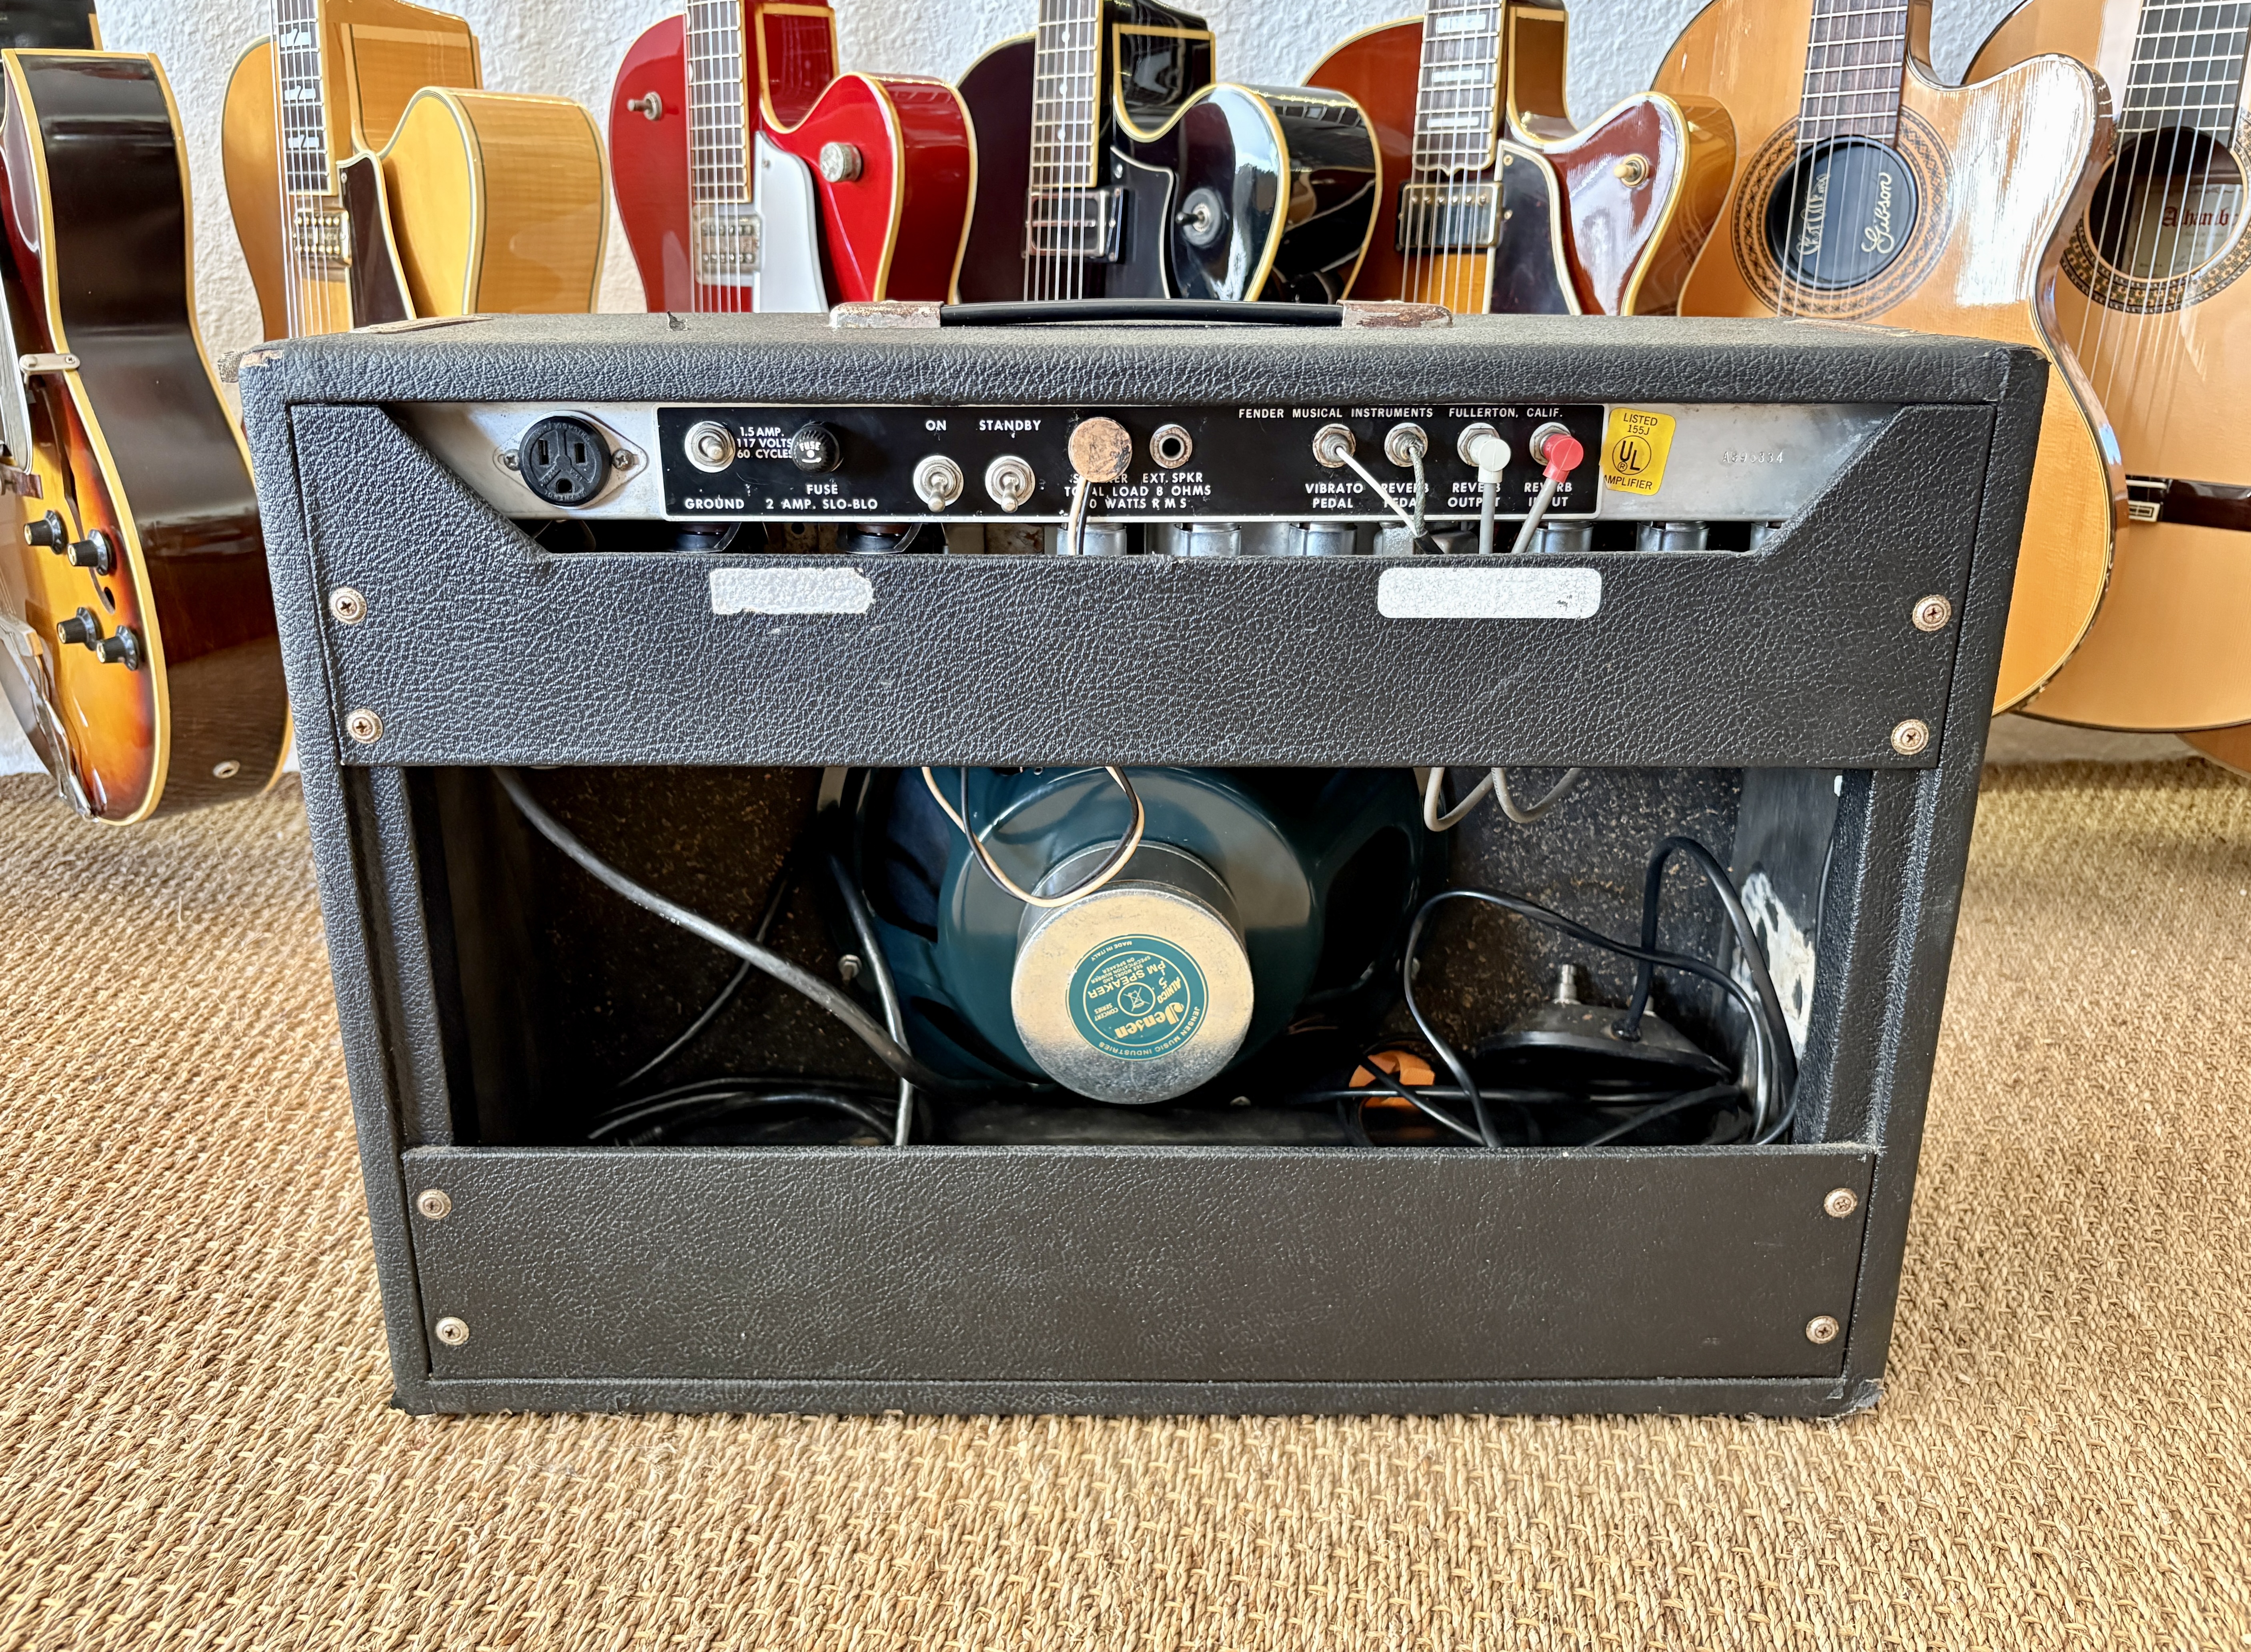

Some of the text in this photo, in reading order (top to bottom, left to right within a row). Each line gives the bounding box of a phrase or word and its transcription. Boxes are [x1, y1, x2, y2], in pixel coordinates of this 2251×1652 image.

[1861, 172, 1894, 254] Gibson
[1239, 408, 1563, 418] FENDER MUSICAL INSTRUMENTS FULLERTON, CALIF.
[1623, 412, 1658, 426] LISTED
[925, 420, 947, 431] ON
[979, 420, 1041, 431] STANDBY
[1627, 424, 1650, 435] 155J
[740, 427, 785, 437] 1.5 AMP.
[737, 438, 792, 448] 117 VOLTS
[799, 441, 821, 452] FUSE
[1619, 440, 1640, 471] UL
[1143, 472, 1203, 484] EXT. SPKR
[807, 484, 838, 495] FUSE
[1064, 485, 1211, 497] TAL LOAD 8 OHMS
[1305, 483, 1364, 494] VIBRATO
[1452, 482, 1501, 493] REVEB
[1524, 482, 1572, 493] RERB
[685, 498, 745, 510] GROUND
[765, 498, 878, 510] 2 AMP. SLO-BLO
[1105, 498, 1146, 509] WATTS
[1152, 499, 1160, 509] R
[1164, 499, 1176, 508] M
[1180, 498, 1186, 508] S
[1312, 498, 1353, 509] PEDAL
[1447, 497, 1500, 508] OUTPT
[1528, 496, 1568, 507] IUT
[1114, 941, 1132, 949] MADE
[1091, 949, 1106, 961] ITALY
[1091, 955, 1151, 984] SPECIFICATION NUMBER
[1102, 961, 1126, 974] SPEAKER
[1087, 960, 1166, 998] PM SPEAKER
[1114, 969, 1132, 978] MODEL
[1157, 976, 1181, 1004] ALNICO
[1094, 1003, 1113, 1014] SERIES
[1094, 1007, 1119, 1021] CONCERT
[1114, 1002, 1184, 1038] Jensen
[1099, 1006, 1200, 1056] JENSEN MUSIC INDUSTRIES
